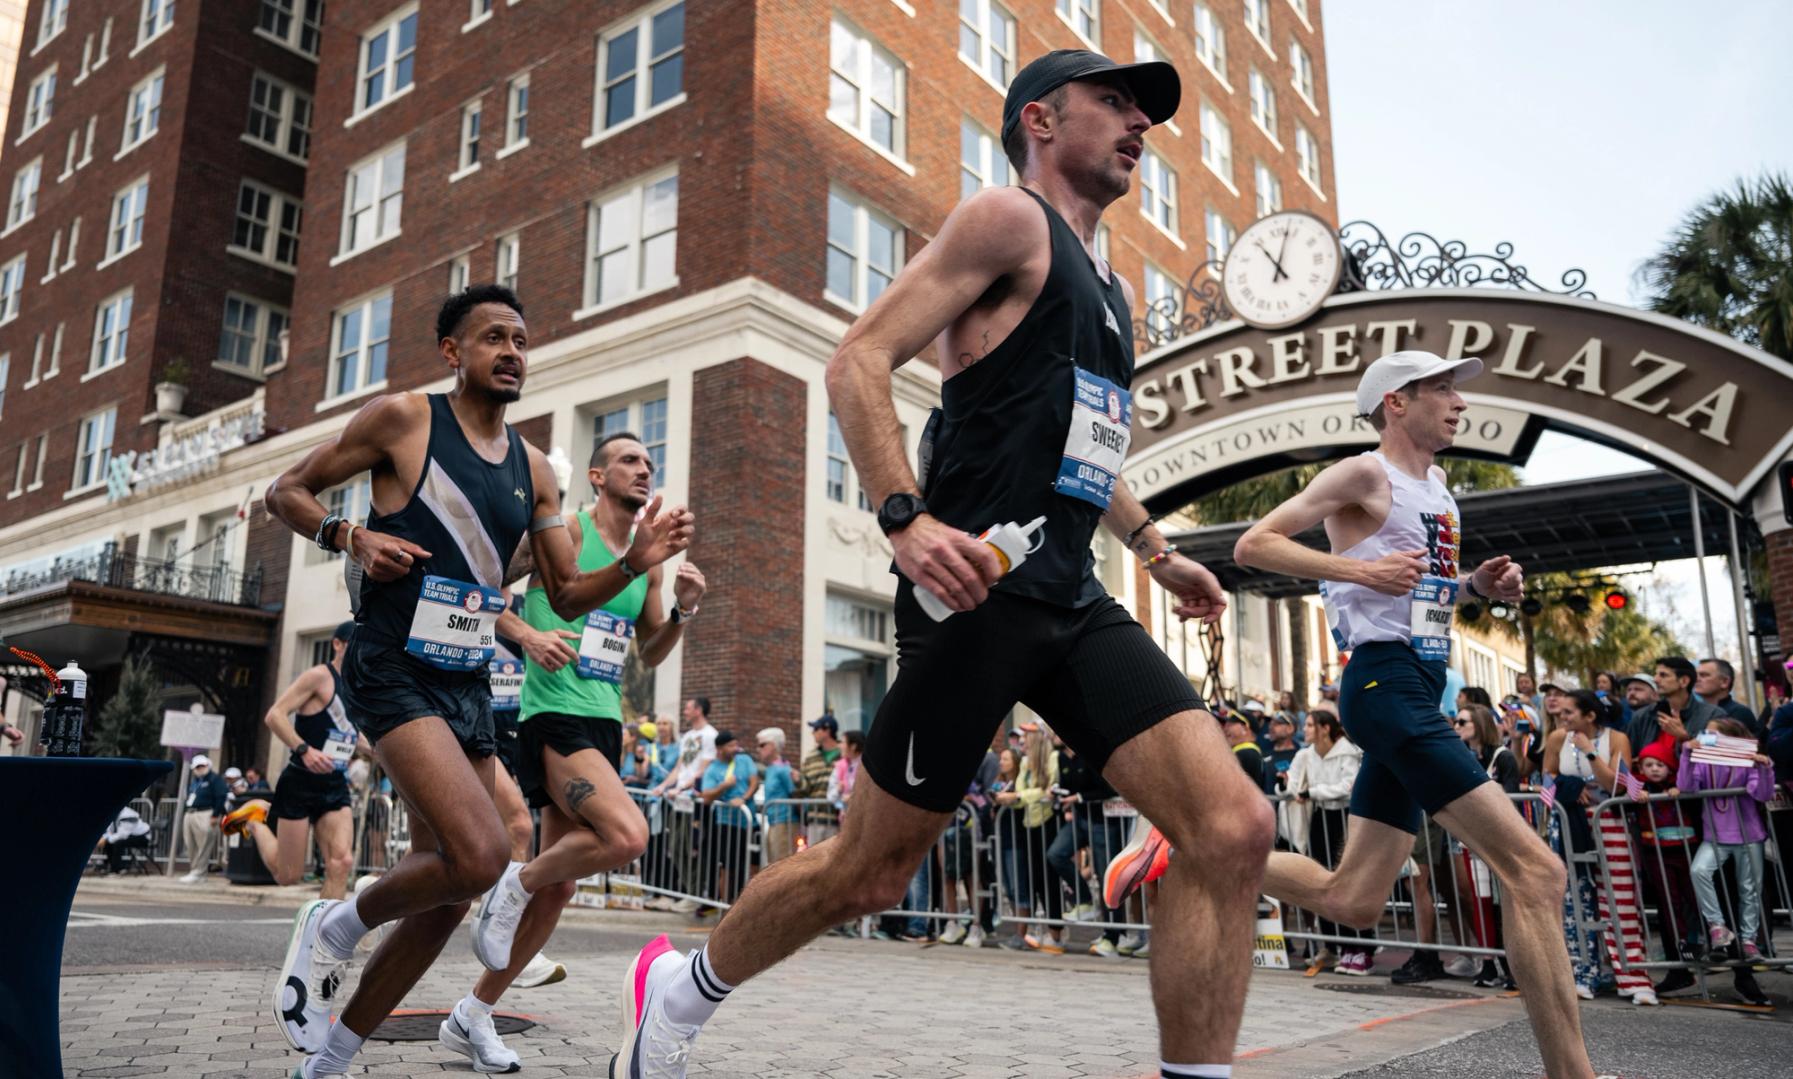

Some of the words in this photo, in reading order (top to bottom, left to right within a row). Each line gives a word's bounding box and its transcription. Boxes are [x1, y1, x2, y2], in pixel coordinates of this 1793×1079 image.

[1134, 319, 1417, 430] STREET
[1446, 319, 1739, 447] PLAZA
[480, 635, 492, 646] 551
[423, 643, 464, 659] ORLANDO
[1255, 935, 1284, 951] tina
[1252, 953, 1266, 966] o!
